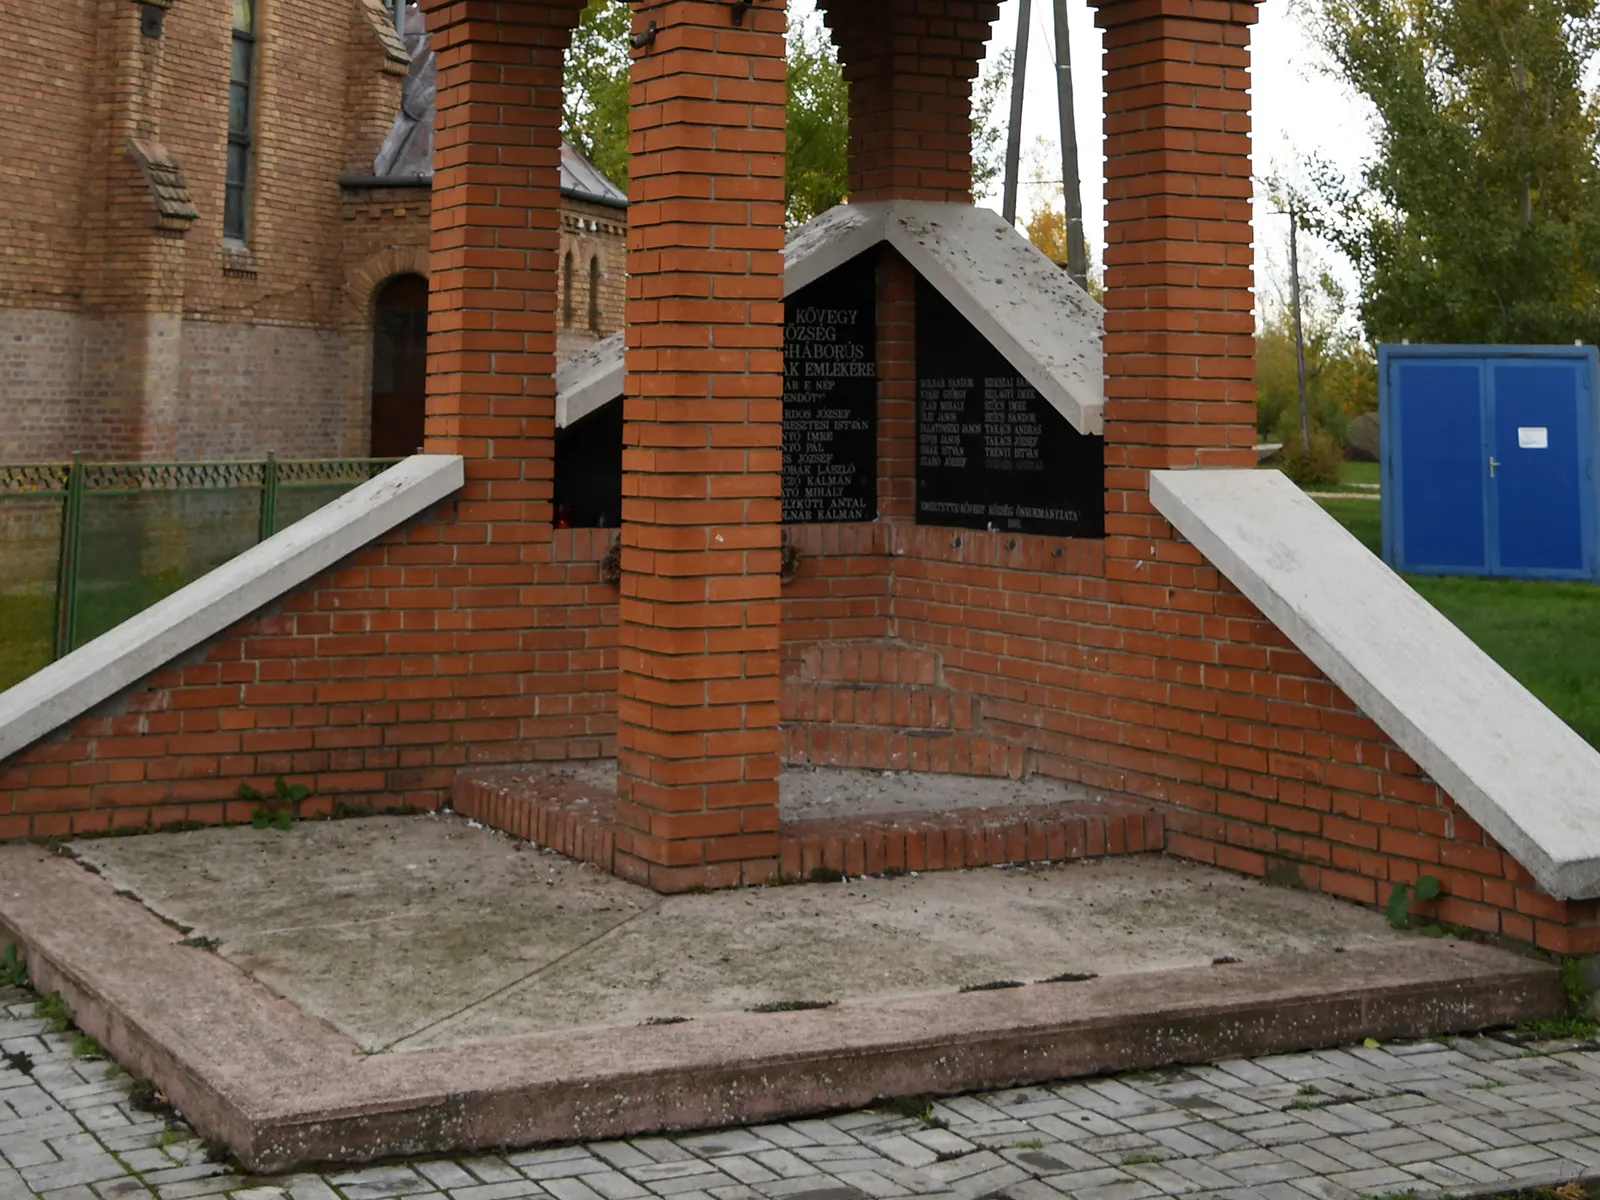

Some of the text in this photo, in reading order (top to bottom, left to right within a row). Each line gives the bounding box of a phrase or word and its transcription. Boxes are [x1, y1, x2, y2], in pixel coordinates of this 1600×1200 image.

[795, 306, 858, 324] KÖVEGY
[783, 322, 837, 341] ÖZSÉG
[804, 358, 876, 377] EMLÉKÉRE
[803, 380, 812, 390] E
[815, 377, 836, 390] NÉP
[815, 406, 852, 419] JÓZSEF
[834, 416, 869, 430] ISTVÁN
[807, 431, 833, 441] IMRE
[817, 461, 856, 475] LÁSZLÓ
[804, 485, 844, 497] MIHÁLY
